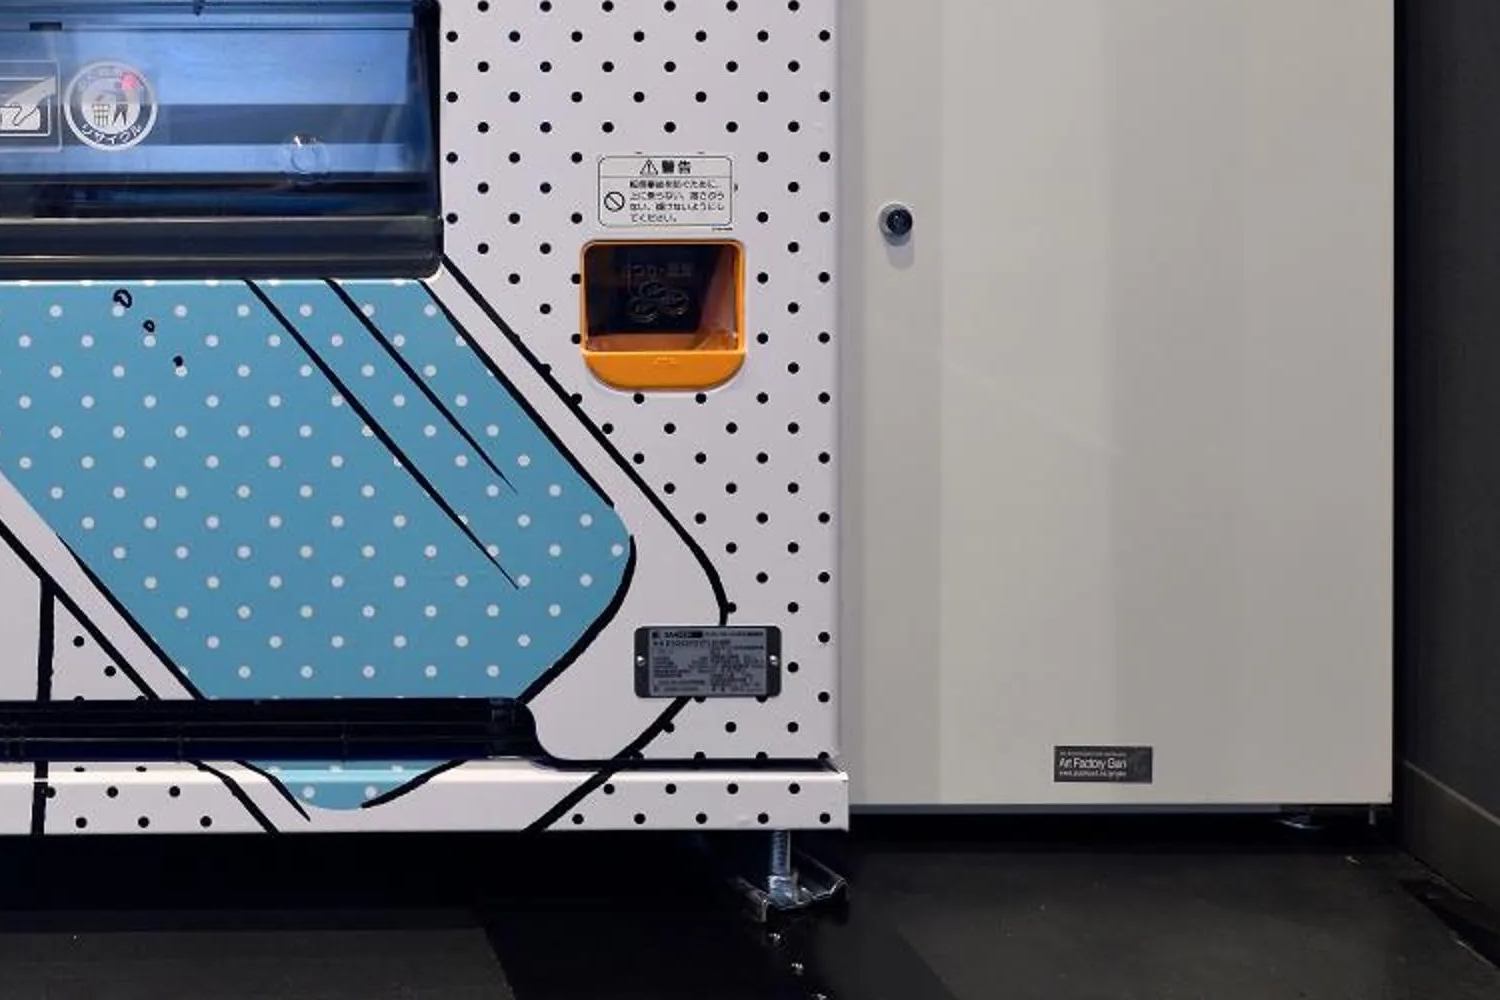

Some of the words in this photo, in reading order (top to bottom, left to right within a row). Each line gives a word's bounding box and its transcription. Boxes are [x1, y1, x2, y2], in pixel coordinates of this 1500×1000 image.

[81, 122, 142, 145] リサイクル
[661, 159, 691, 175] 警告
